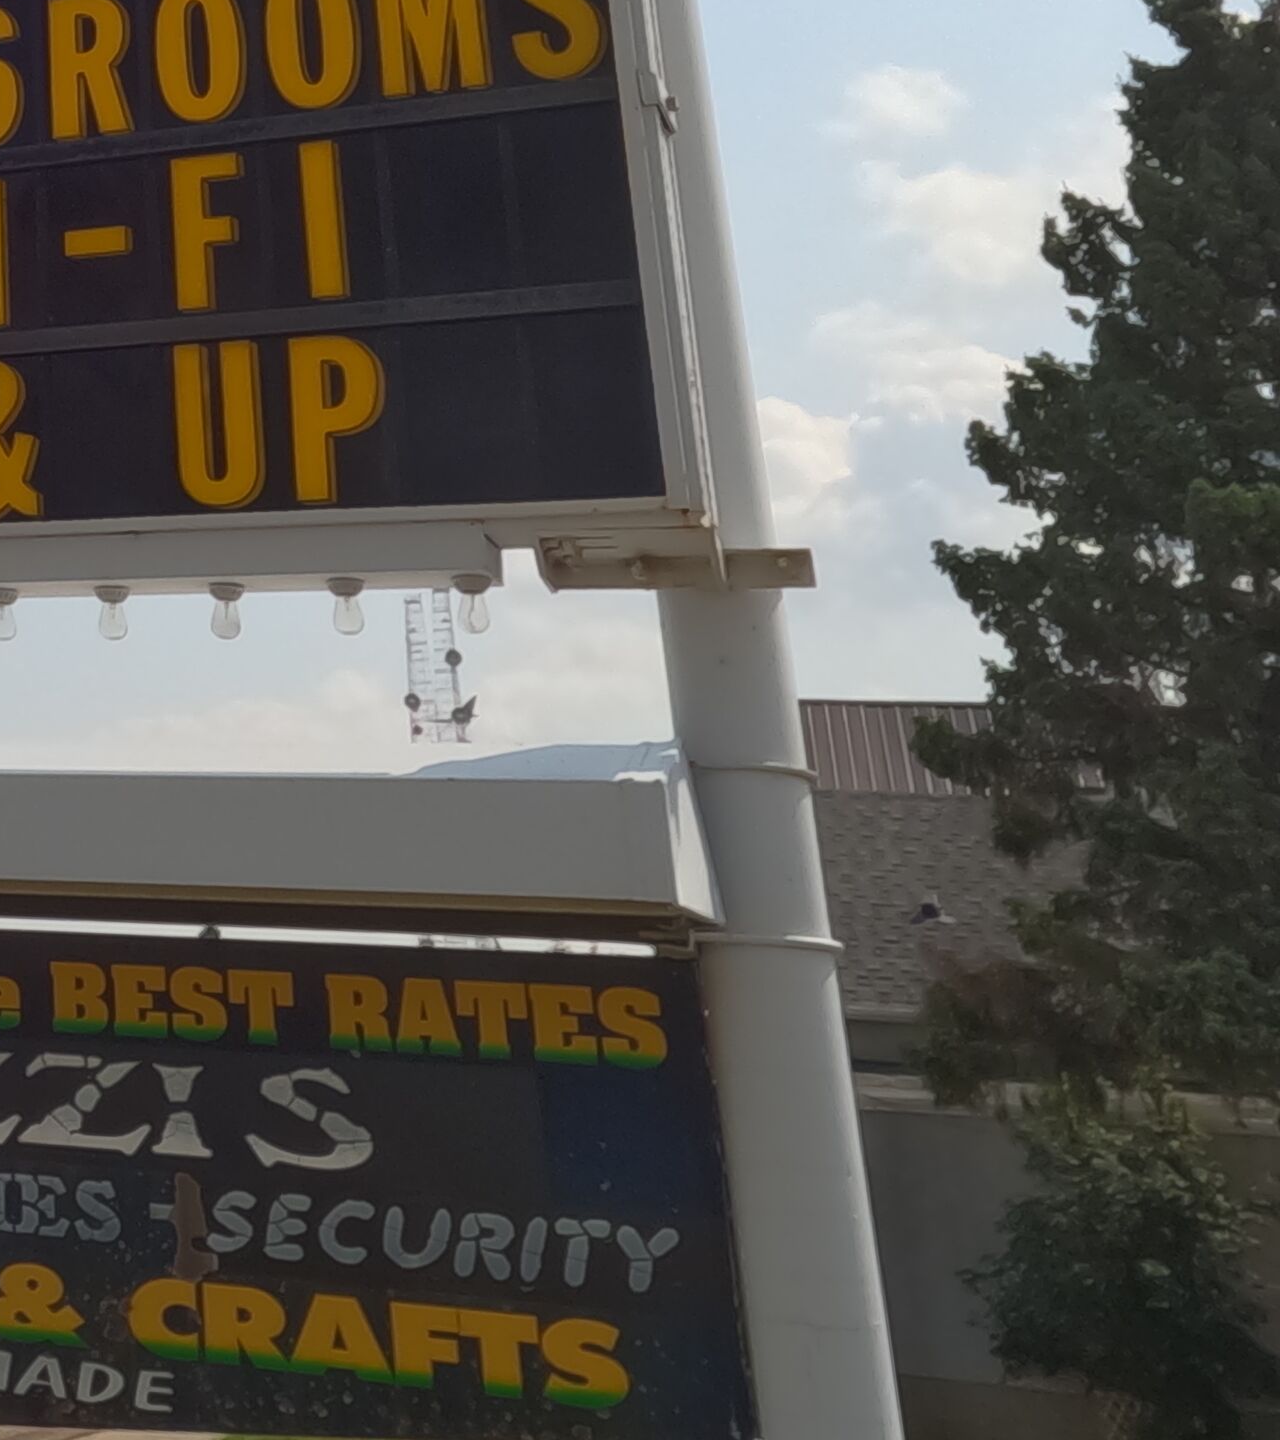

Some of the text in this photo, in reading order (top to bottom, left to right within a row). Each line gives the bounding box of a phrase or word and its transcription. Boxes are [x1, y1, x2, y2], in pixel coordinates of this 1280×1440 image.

[173, 335, 385, 509] UP
[50, 961, 294, 1046] BEST
[325, 974, 669, 1069] RATES
[206, 1190, 680, 1293] SECURITY
[127, 1277, 630, 1409] CRAFTS
